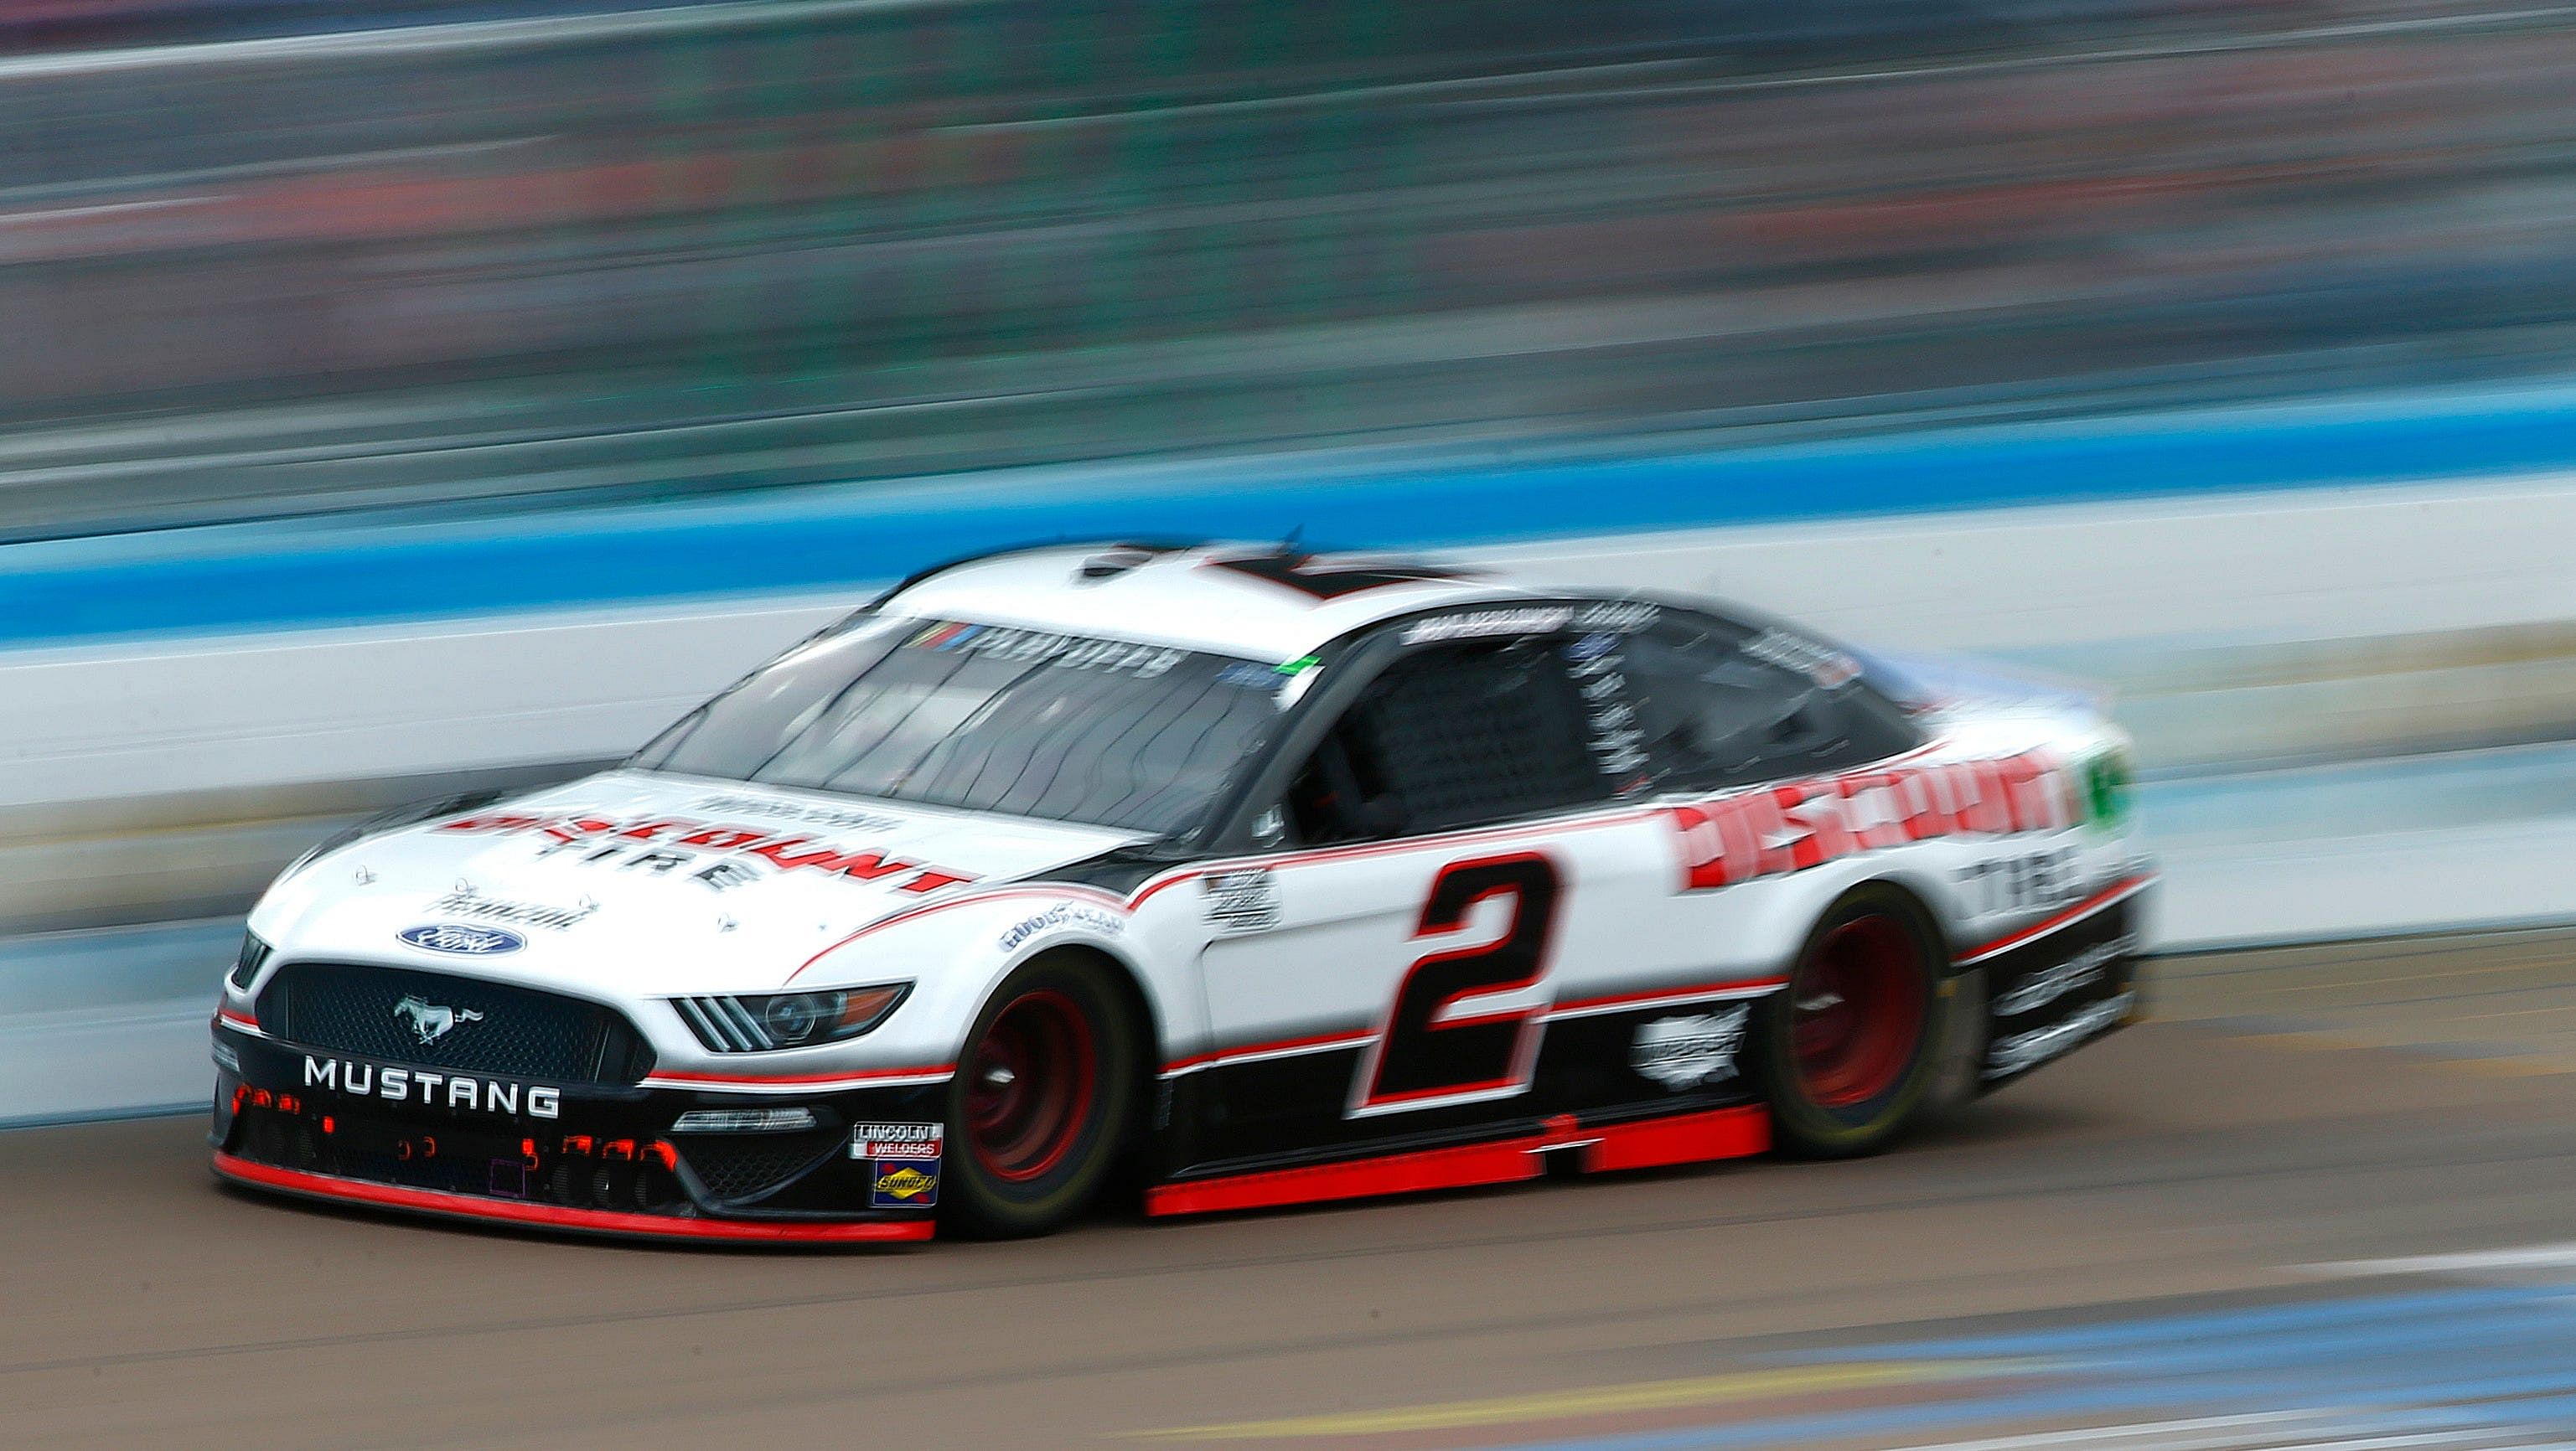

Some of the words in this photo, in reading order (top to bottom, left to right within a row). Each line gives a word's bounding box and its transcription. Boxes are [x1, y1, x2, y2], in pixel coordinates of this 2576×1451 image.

[1349, 849, 1567, 1118] 2
[304, 1055, 561, 1120] MUSTANG
[856, 1125, 929, 1140] LINCOLN
[874, 1143, 935, 1155] WELDERS
[877, 1175, 938, 1190] SUNOCO
